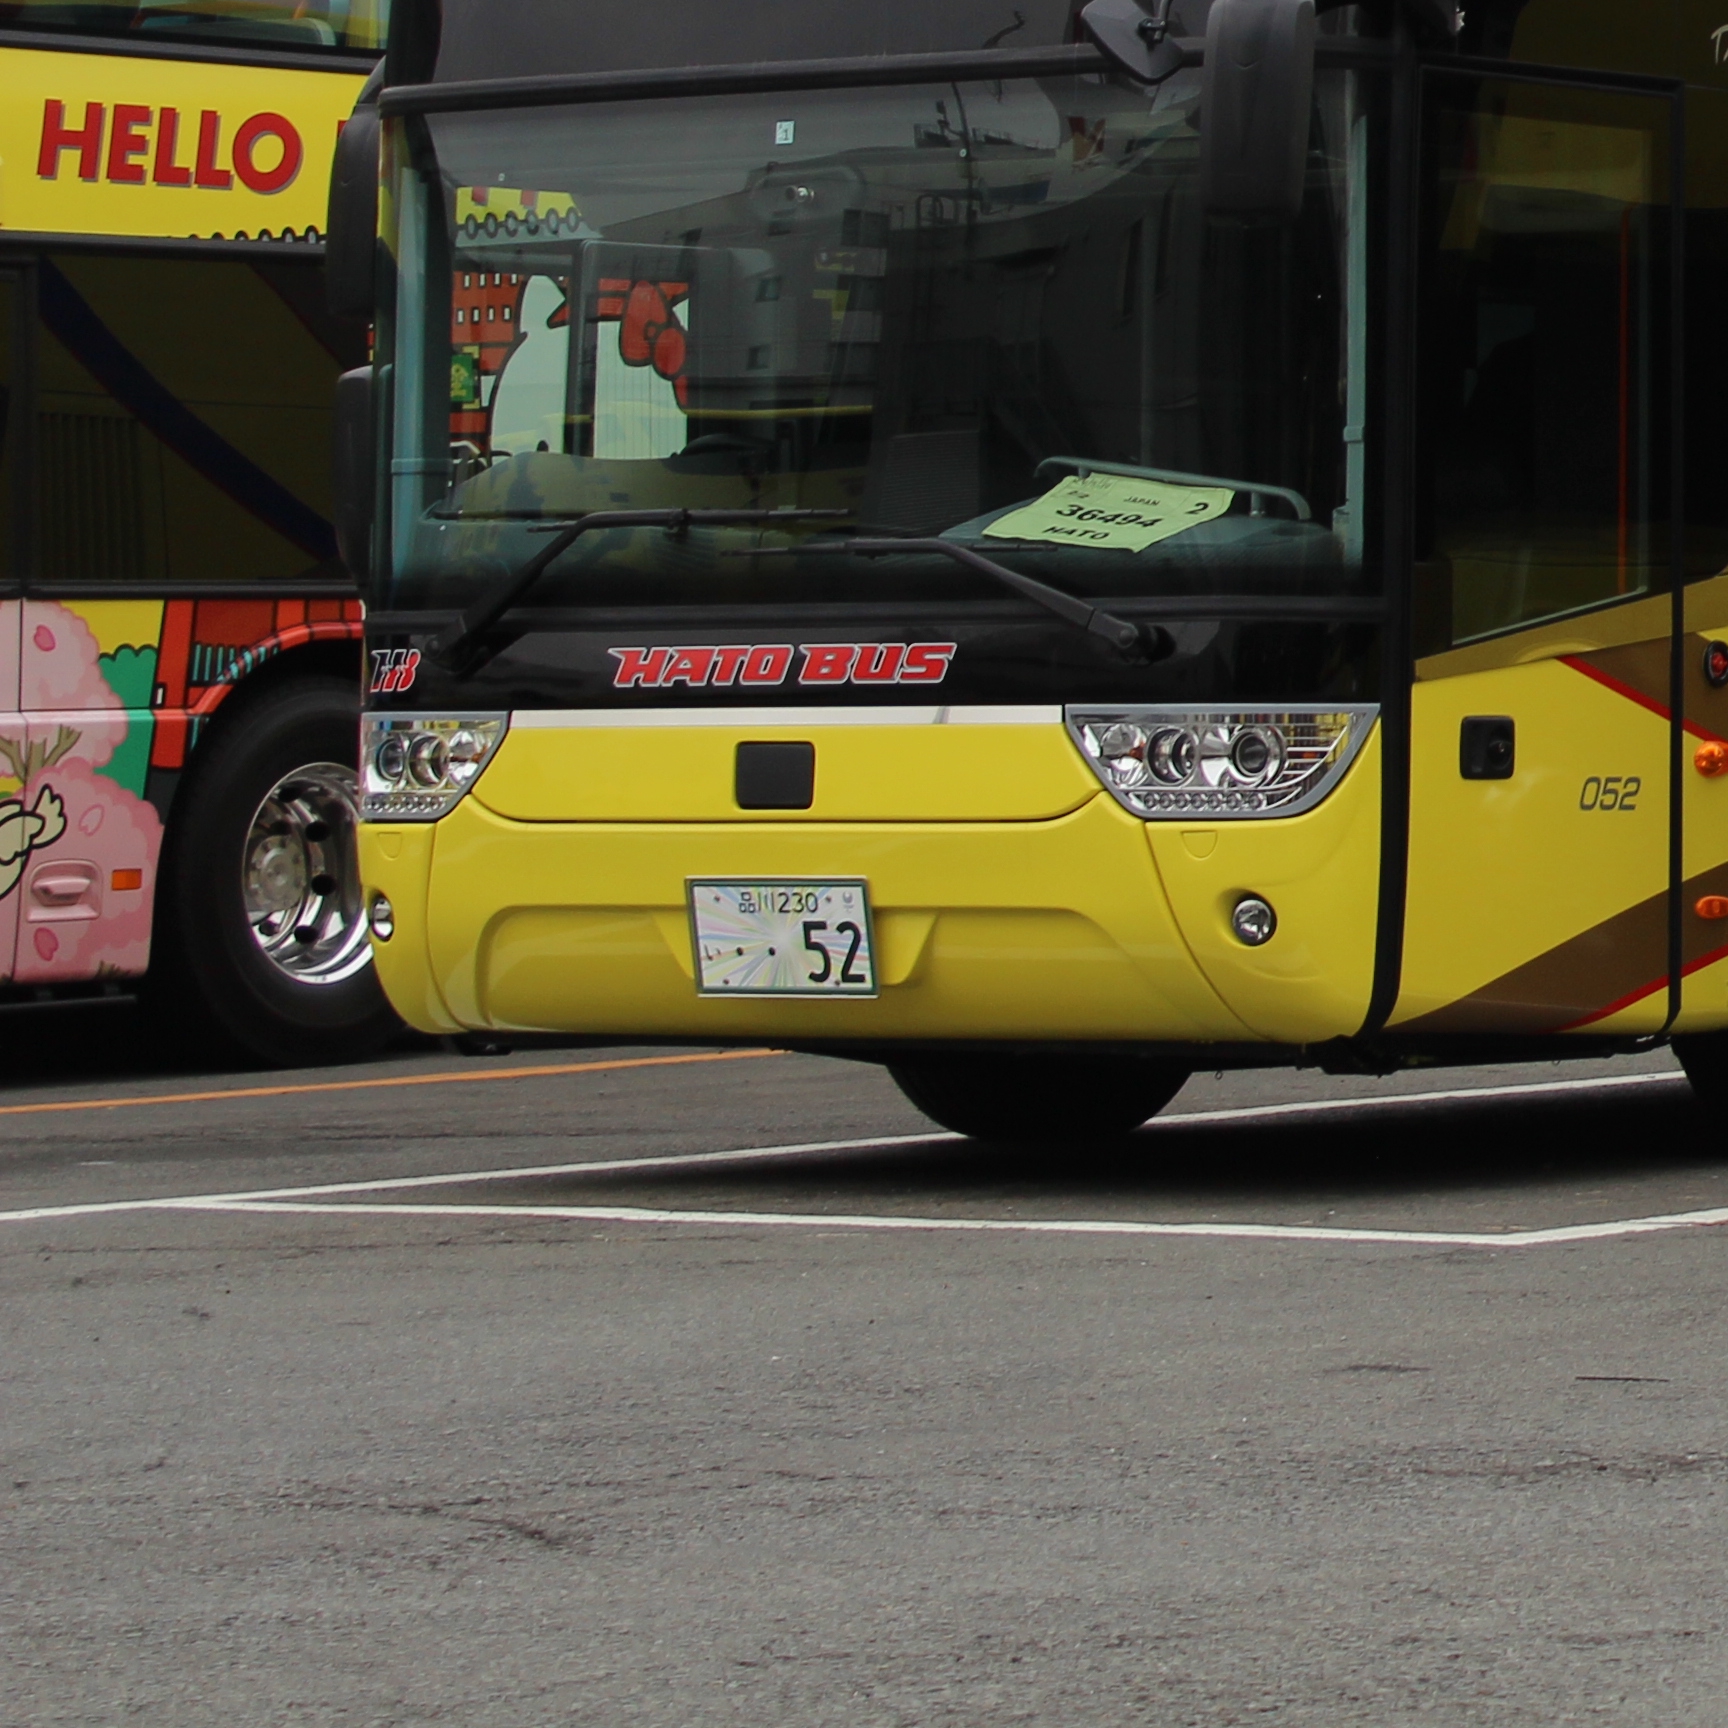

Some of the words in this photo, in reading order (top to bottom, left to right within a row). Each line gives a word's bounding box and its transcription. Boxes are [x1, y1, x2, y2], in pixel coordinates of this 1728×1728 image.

[37, 99, 304, 195] HELLO
[1056, 503, 1164, 528] 36494
[1123, 495, 1160, 507] JAPAN
[1042, 525, 1110, 540] HATO
[608, 644, 794, 687] HATO
[799, 642, 957, 685] BUS
[1580, 776, 1641, 811] 052
